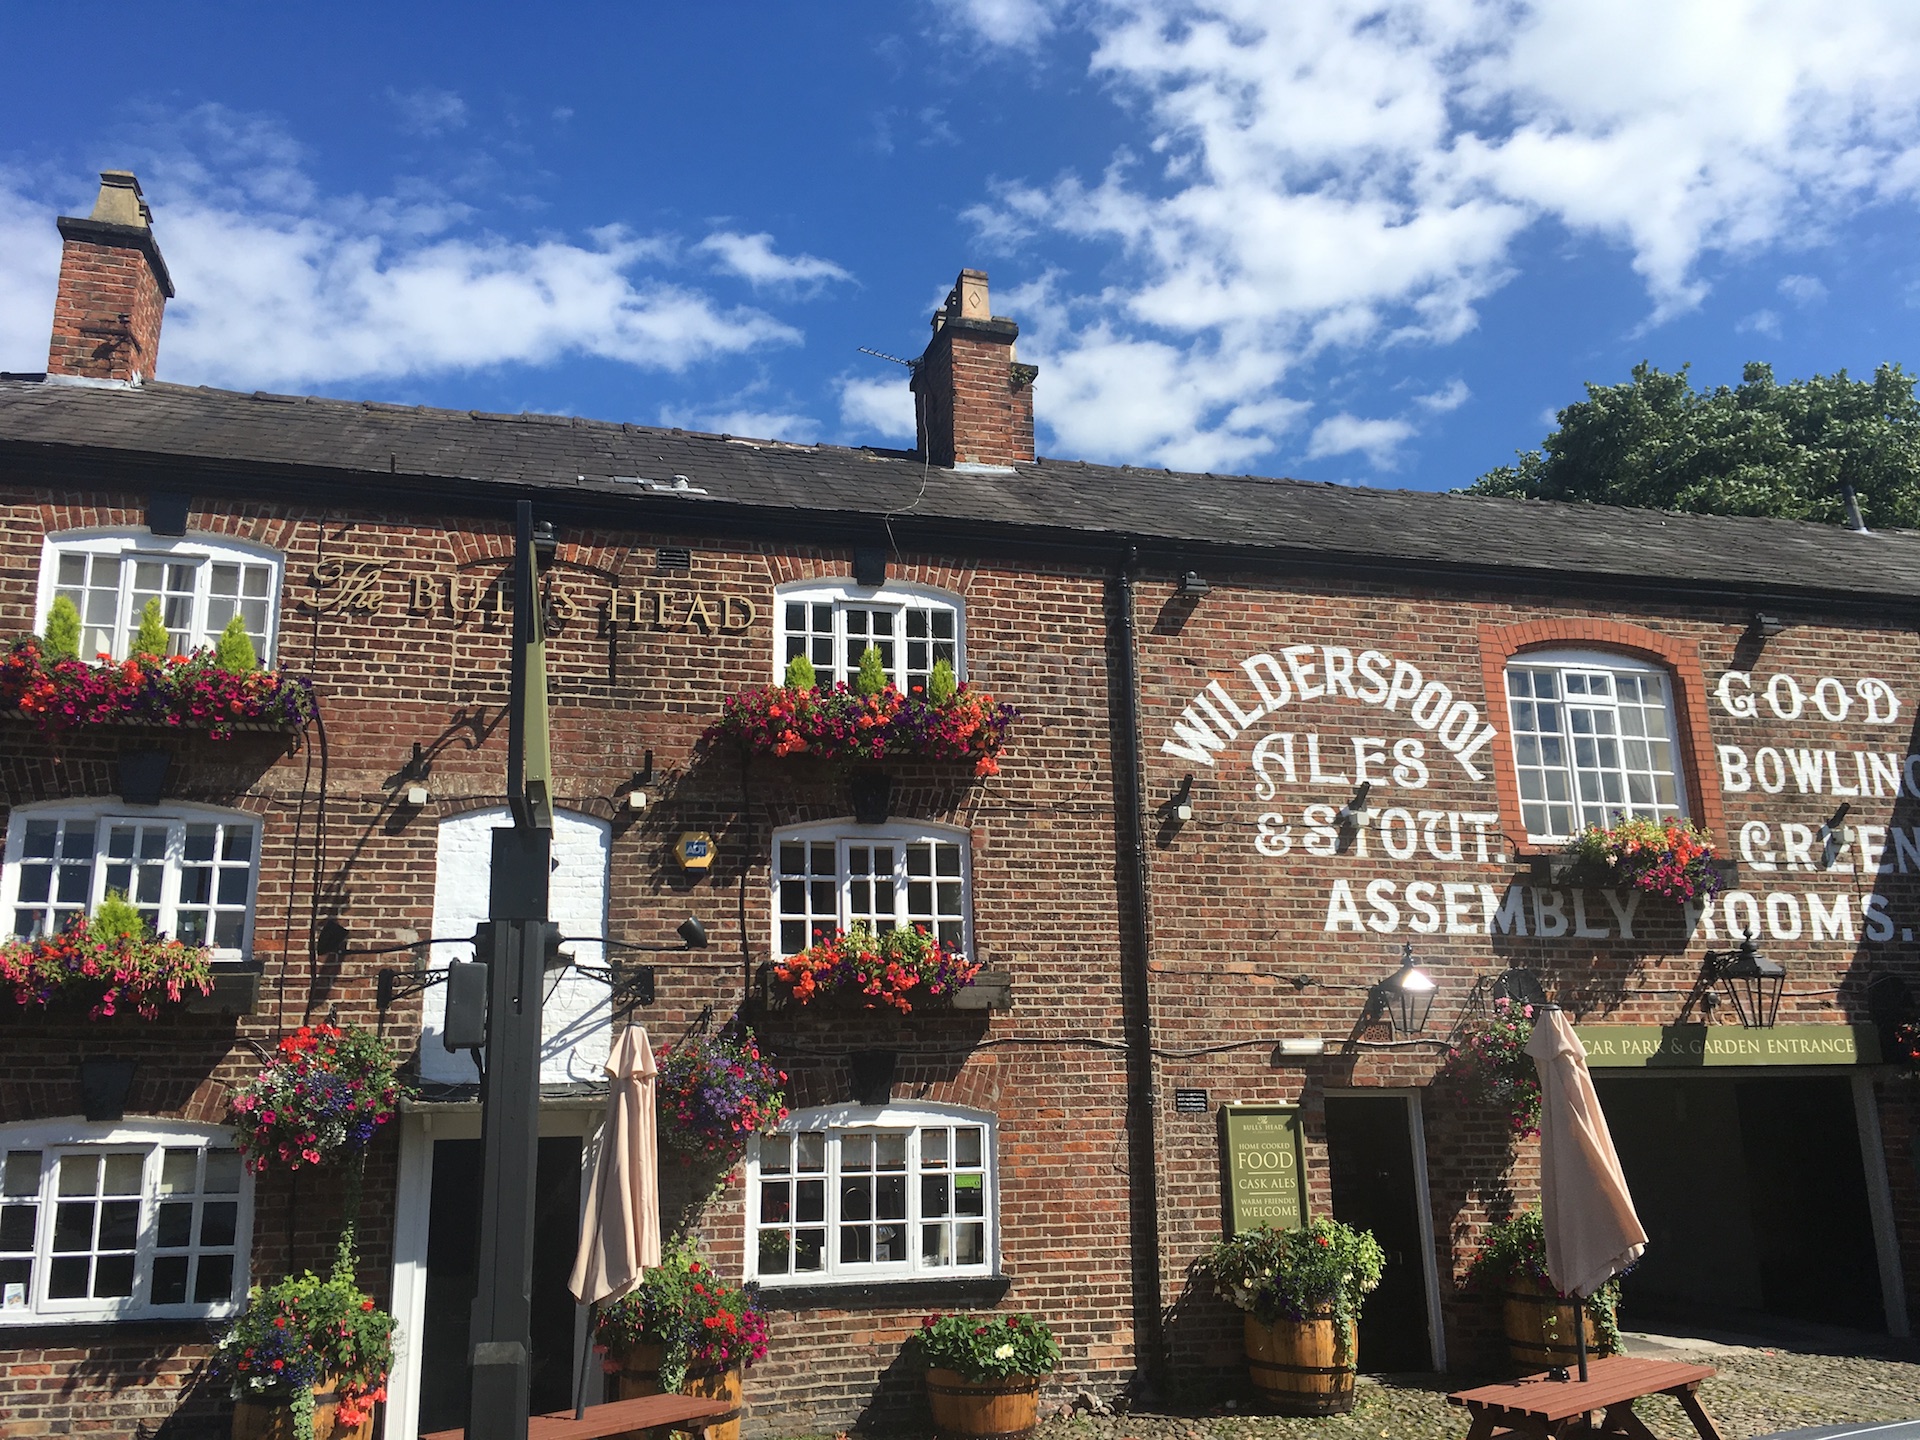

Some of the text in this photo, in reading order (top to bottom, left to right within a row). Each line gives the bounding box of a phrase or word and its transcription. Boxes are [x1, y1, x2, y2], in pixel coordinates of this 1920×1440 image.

[303, 557, 756, 629] The BULS HEAD
[1713, 671, 1902, 724] GOOD
[1160, 645, 1498, 782] WILDERSPOOL
[1251, 733, 1429, 800] ALES
[1254, 812, 1292, 856] &
[686, 844, 706, 854] ADT
[1324, 878, 1914, 941] ASSEMBLY ROOMS.
[1581, 1037, 1855, 1055] CAR PARK & GARDEN ENTRANCE
[1261, 1142, 1290, 1150] COOKED
[1238, 1151, 1294, 1169] FOOD
[1239, 1177, 1296, 1190] CASK ALES
[1264, 1197, 1296, 1205] FRIENDLY
[1241, 1205, 1298, 1217] WELCOME
